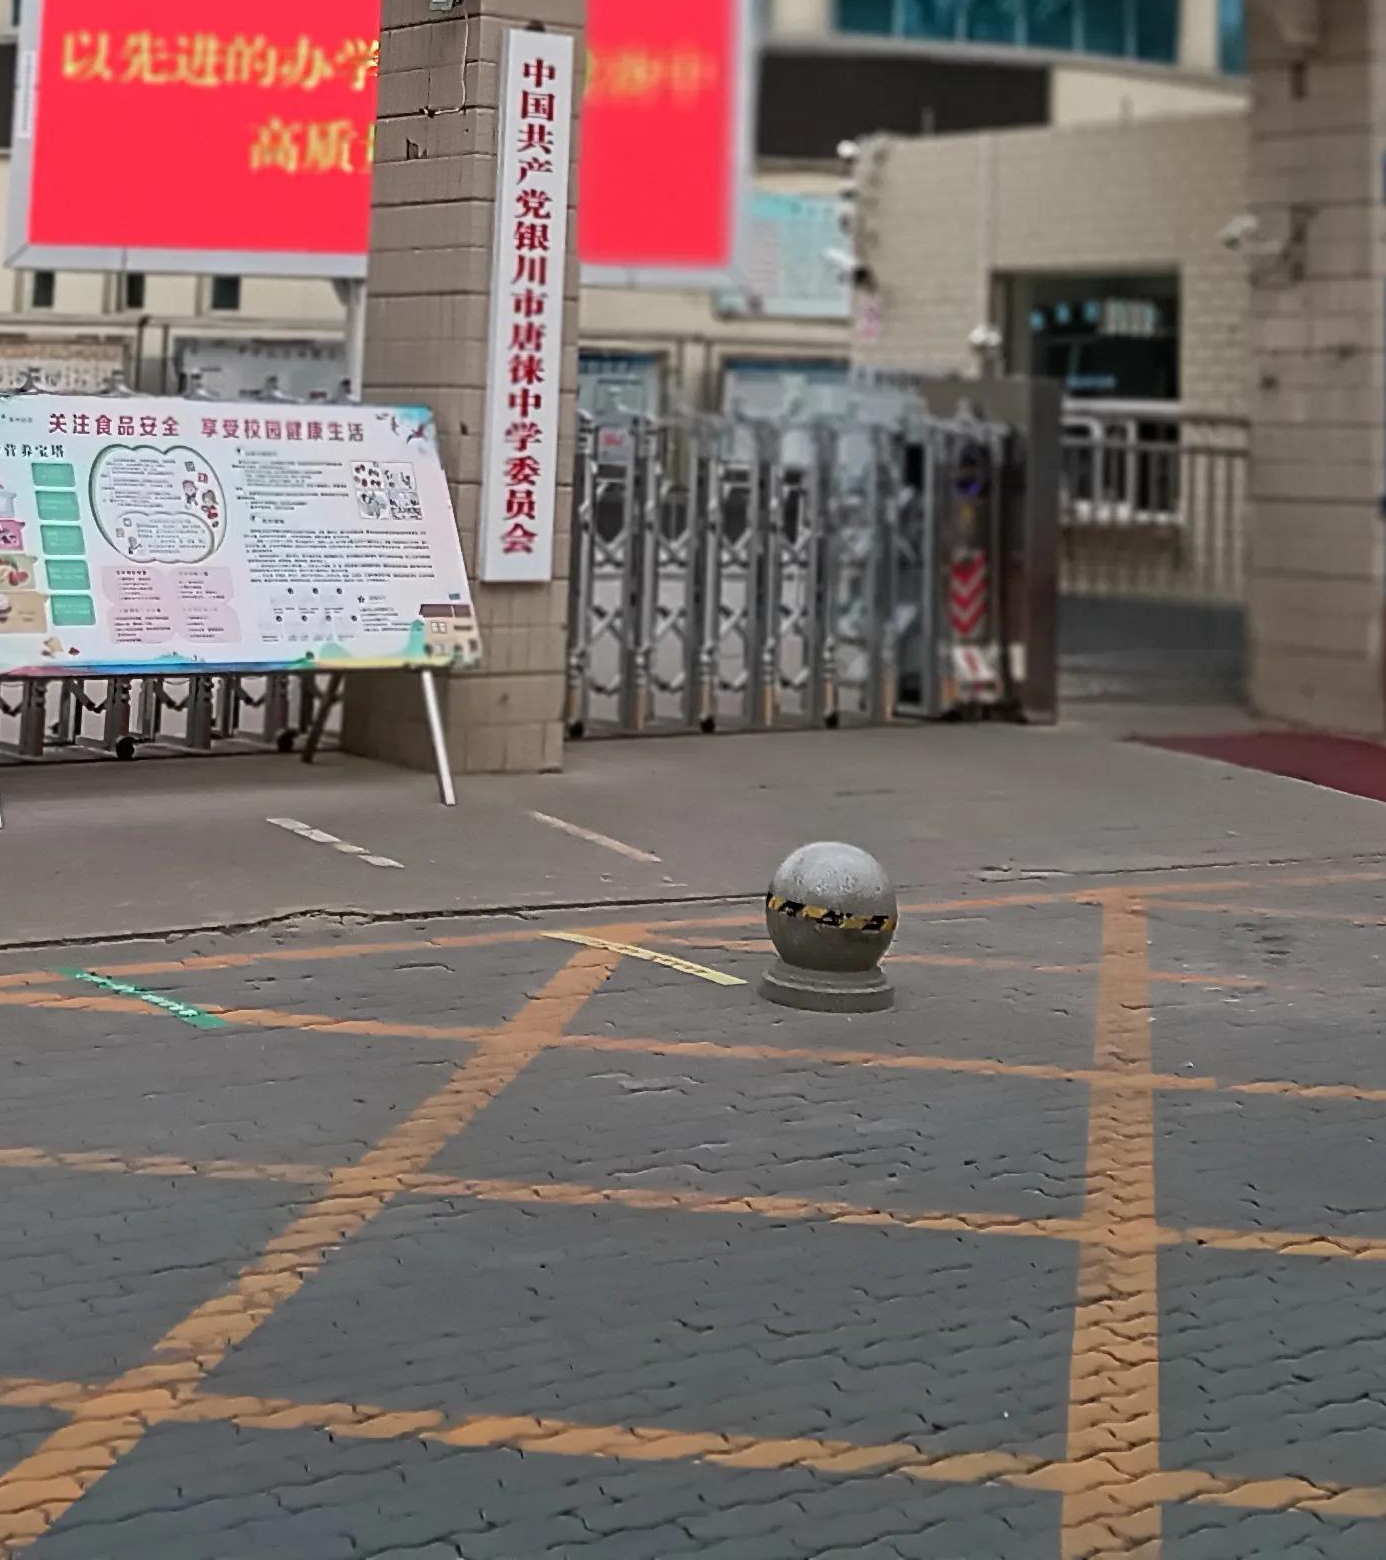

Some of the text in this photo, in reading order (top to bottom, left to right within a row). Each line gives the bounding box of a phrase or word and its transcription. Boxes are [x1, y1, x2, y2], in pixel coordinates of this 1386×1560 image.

[249, 113, 376, 174] 高质
[500, 56, 557, 555] 中国共产党银川市唐徕中学委员会
[49, 412, 365, 442] 关注食品安全 享受校园健康生活
